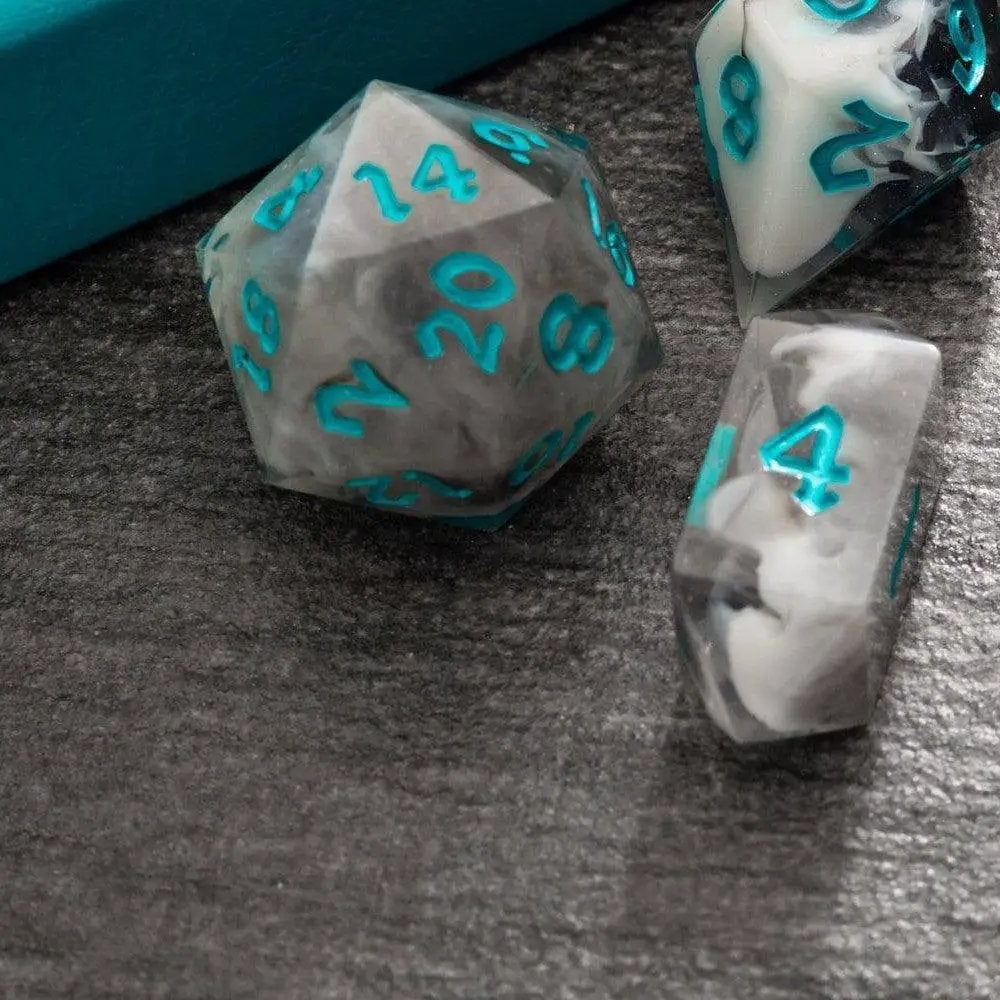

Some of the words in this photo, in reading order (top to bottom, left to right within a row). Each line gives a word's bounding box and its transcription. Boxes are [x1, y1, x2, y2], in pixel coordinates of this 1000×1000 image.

[719, 54, 760, 165] 8
[809, 97, 909, 195] 2
[354, 143, 479, 224] 14
[416, 251, 516, 374] 20
[539, 292, 614, 374] 8
[313, 359, 409, 437] 2
[759, 404, 851, 516] 4
